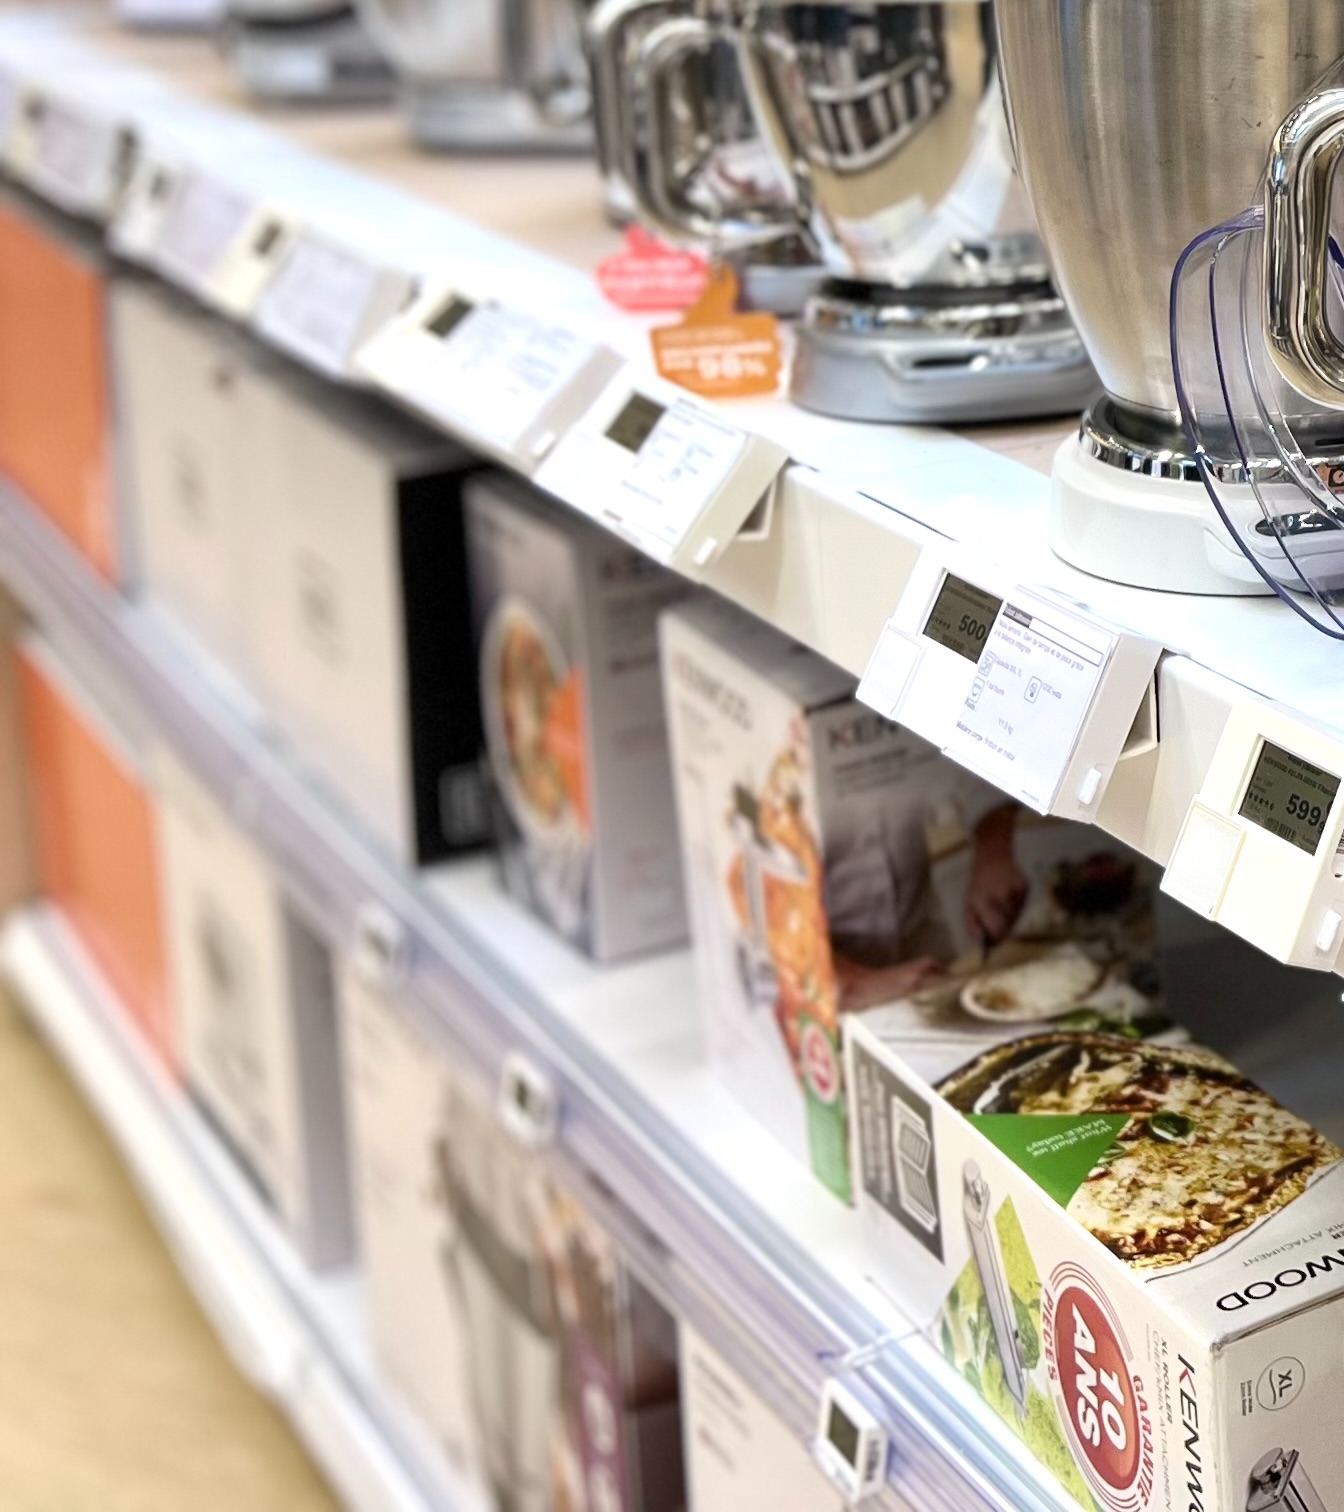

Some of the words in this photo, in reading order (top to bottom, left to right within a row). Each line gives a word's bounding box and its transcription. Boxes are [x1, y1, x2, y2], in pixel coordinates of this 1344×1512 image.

[1242, 1231, 1323, 1267] ATTACHMENT
[1072, 1302, 1101, 1448] ANS
[1100, 1367, 1127, 1451] 10
[1162, 1361, 1174, 1425] ROLLER
[1278, 1369, 1293, 1398] XL
[1133, 1374, 1154, 1507] GARANTIE
[1159, 1418, 1173, 1512] ATTACHMEN
[1177, 1353, 1205, 1512] KENW
